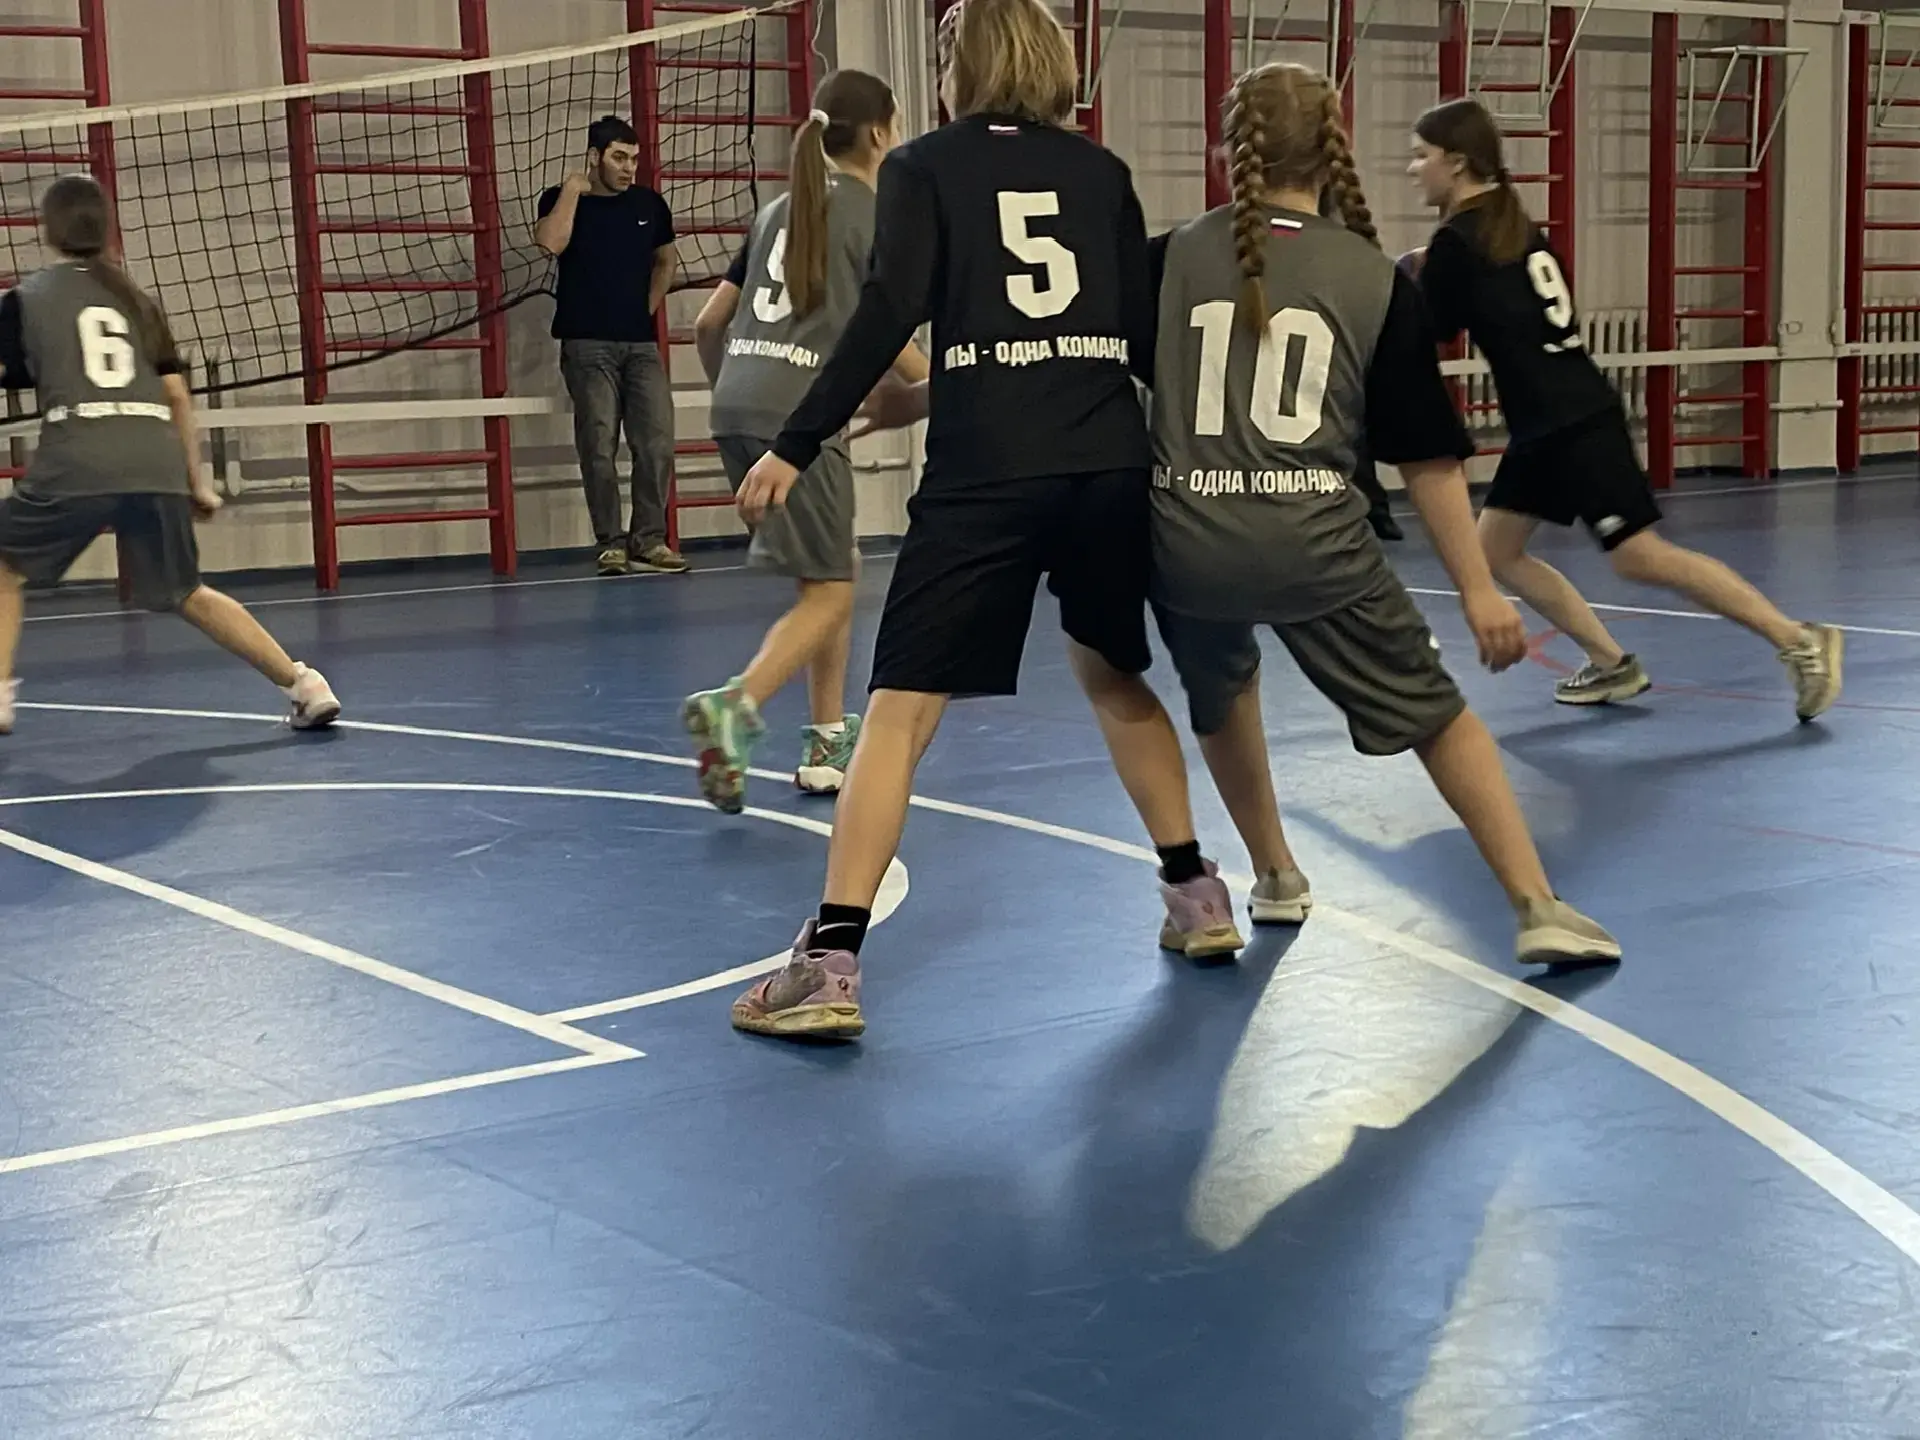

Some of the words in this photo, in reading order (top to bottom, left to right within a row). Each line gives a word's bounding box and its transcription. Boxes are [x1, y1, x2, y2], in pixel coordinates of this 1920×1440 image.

[997, 190, 1081, 319] 5
[1525, 250, 1573, 329] 9
[77, 305, 136, 388] 6
[995, 339, 1053, 367] ОДНА
[1189, 299, 1335, 445] 10
[1189, 468, 1245, 497] ОДНА
[1250, 468, 1347, 495] КОМАНДА!
